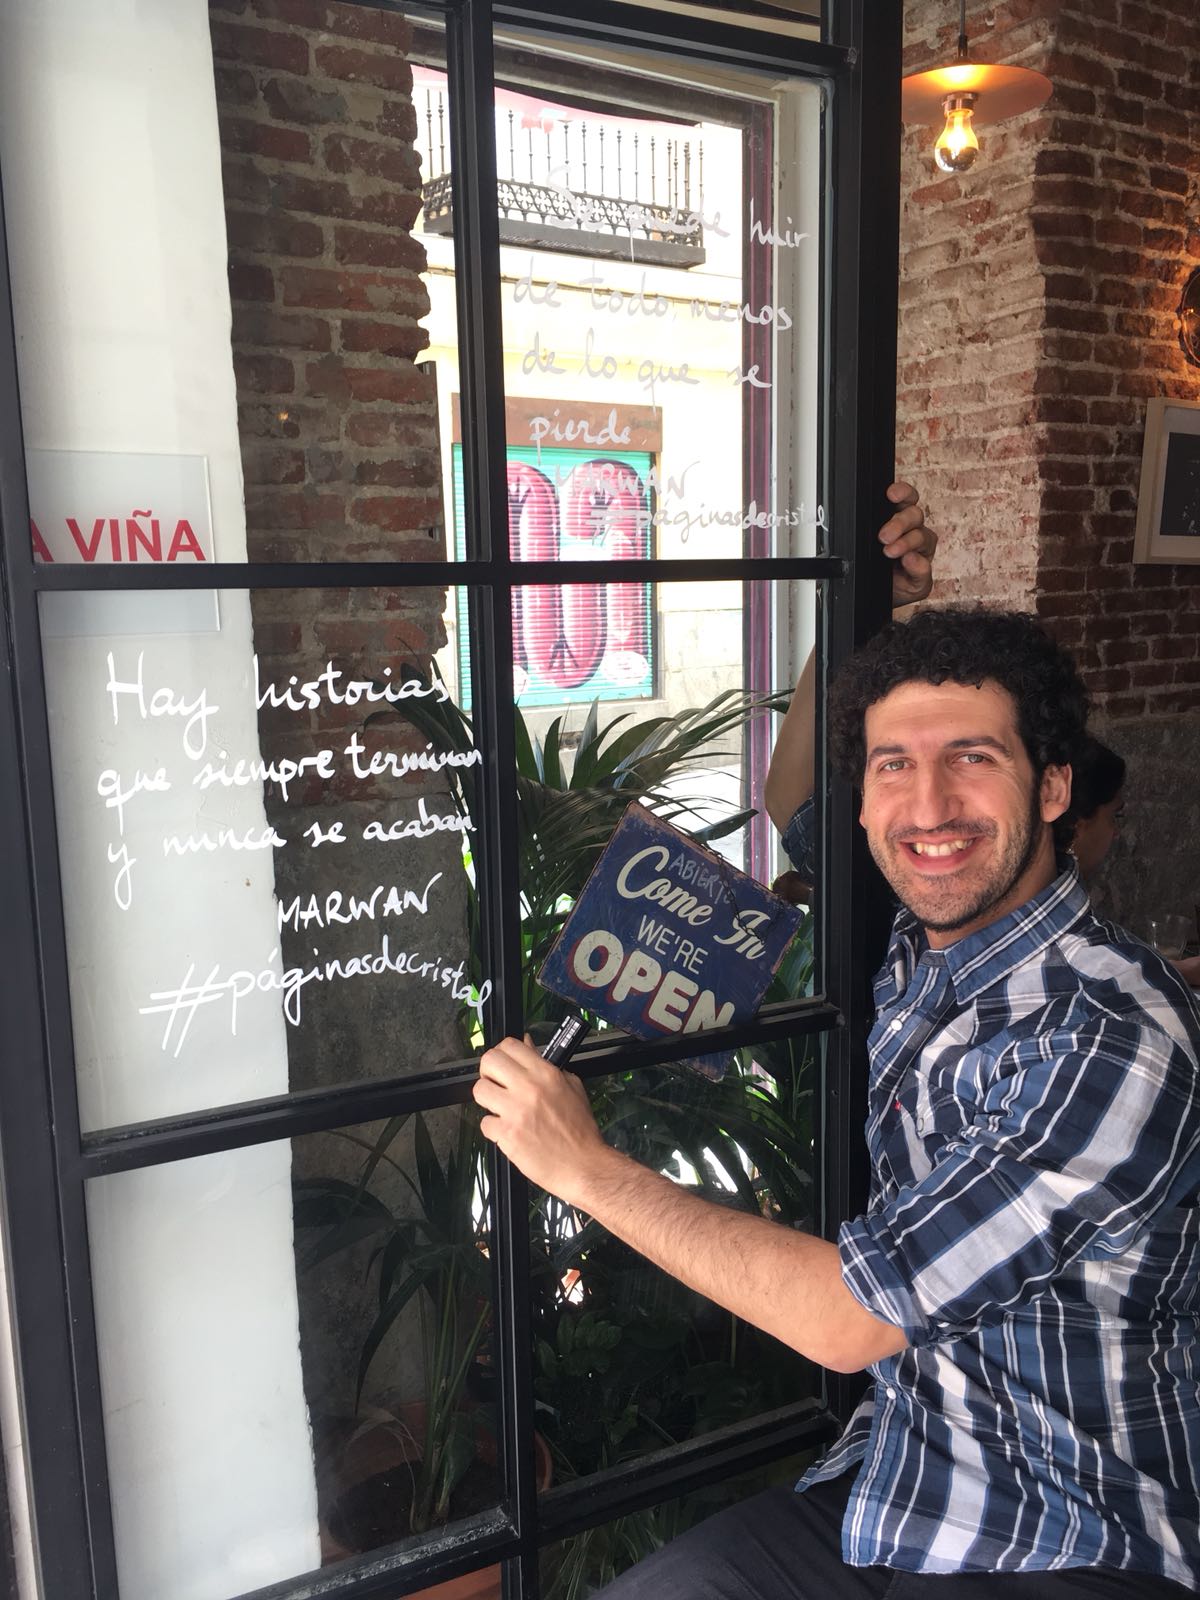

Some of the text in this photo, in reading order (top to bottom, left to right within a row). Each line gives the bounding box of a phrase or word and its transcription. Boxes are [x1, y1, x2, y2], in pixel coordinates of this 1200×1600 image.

[749, 198, 811, 249] huir
[513, 256, 562, 307] de
[690, 298, 793, 331] menos
[522, 328, 772, 416] de lo que se
[554, 461, 701, 499] MARWAN
[65, 509, 207, 562] VIÑA
[105, 651, 451, 760] Hay historias
[97, 732, 483, 836] que siempre terminan
[106, 839, 137, 911] y
[163, 825, 287, 857] nunca
[302, 820, 347, 848] se
[276, 871, 443, 934] MARWAN
[616, 845, 771, 960] Come In
[572, 929, 736, 1034] OPEN
[635, 914, 709, 975] WE'RE
[138, 934, 493, 1058] #páginasdecristal
